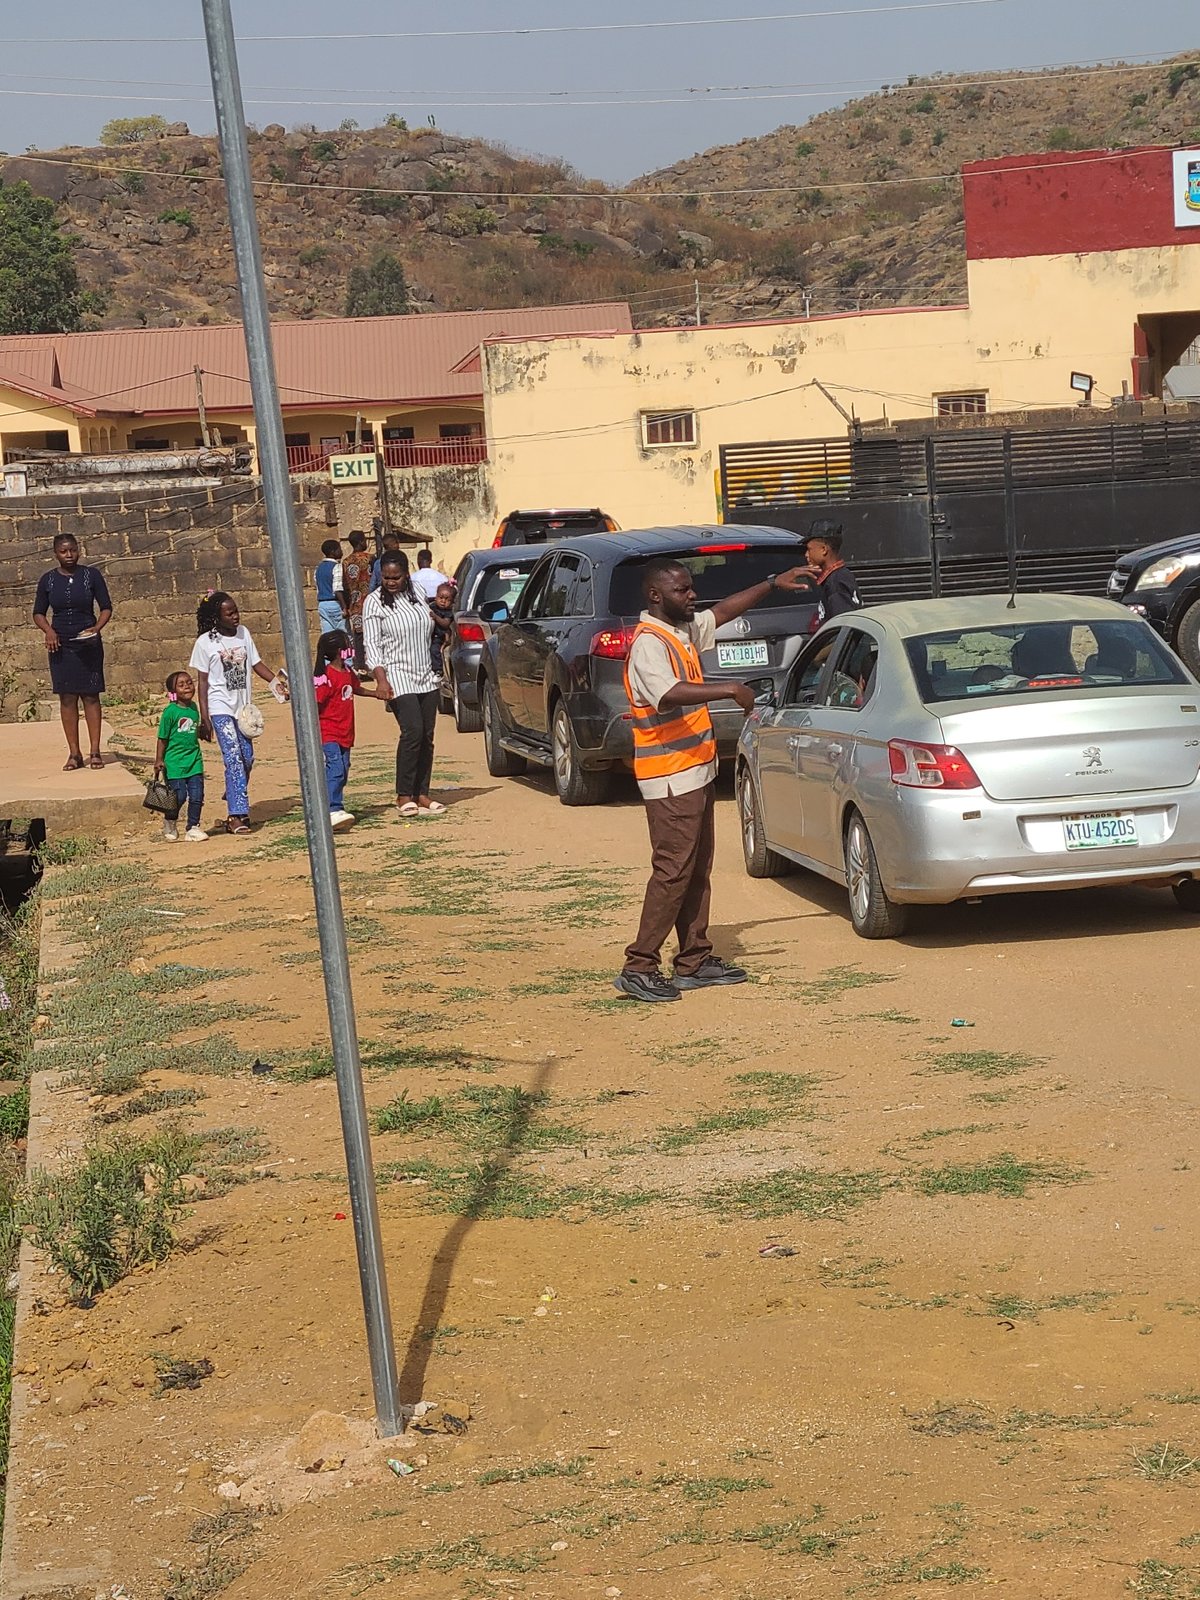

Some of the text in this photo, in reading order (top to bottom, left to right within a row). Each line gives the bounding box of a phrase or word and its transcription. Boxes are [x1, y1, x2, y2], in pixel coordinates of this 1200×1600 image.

[333, 459, 374, 478] EXIT
[719, 646, 766, 661] EKY-181HP
[1066, 818, 1135, 841] KTU-452DS
